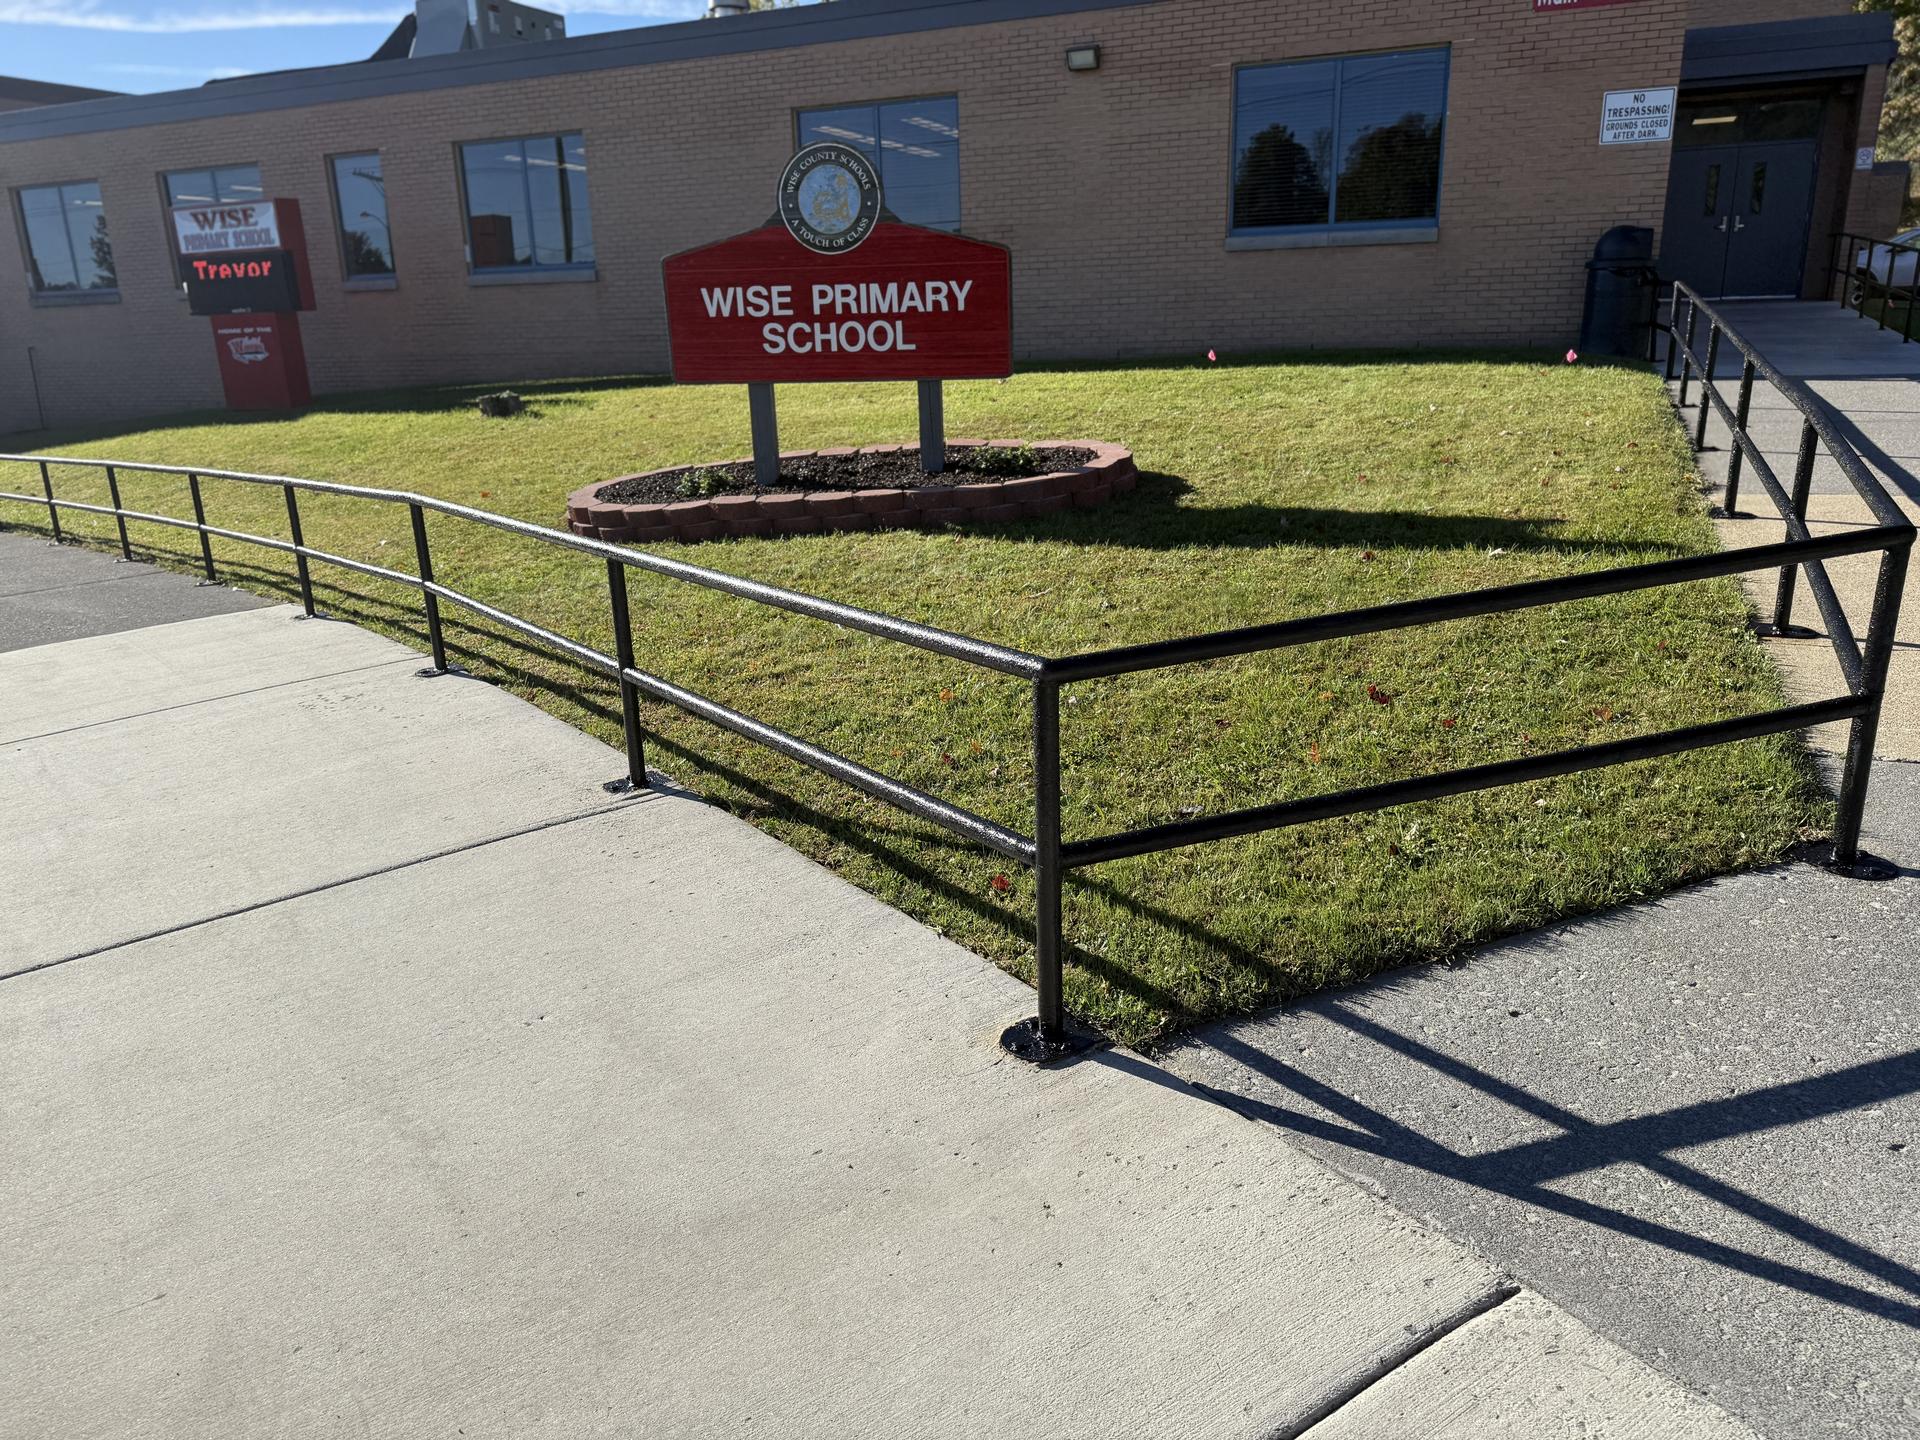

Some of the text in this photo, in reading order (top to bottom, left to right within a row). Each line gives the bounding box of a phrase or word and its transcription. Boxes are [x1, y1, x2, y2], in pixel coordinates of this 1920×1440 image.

[1633, 94, 1646, 104] NO
[1607, 104, 1671, 118] TRESPASSING!
[1606, 119, 1669, 131] GROUNDS CLOSED
[1612, 128, 1660, 140] AFTER DARK.
[787, 151, 871, 193] WISE COUNTY SCHOOLS
[190, 207, 258, 231] WISE
[232, 228, 275, 247] SCHOOL
[791, 217, 869, 248] A TOUCH OF CLASS
[700, 279, 973, 318] WISE PRIMARY
[762, 320, 917, 354] SCHOOL
